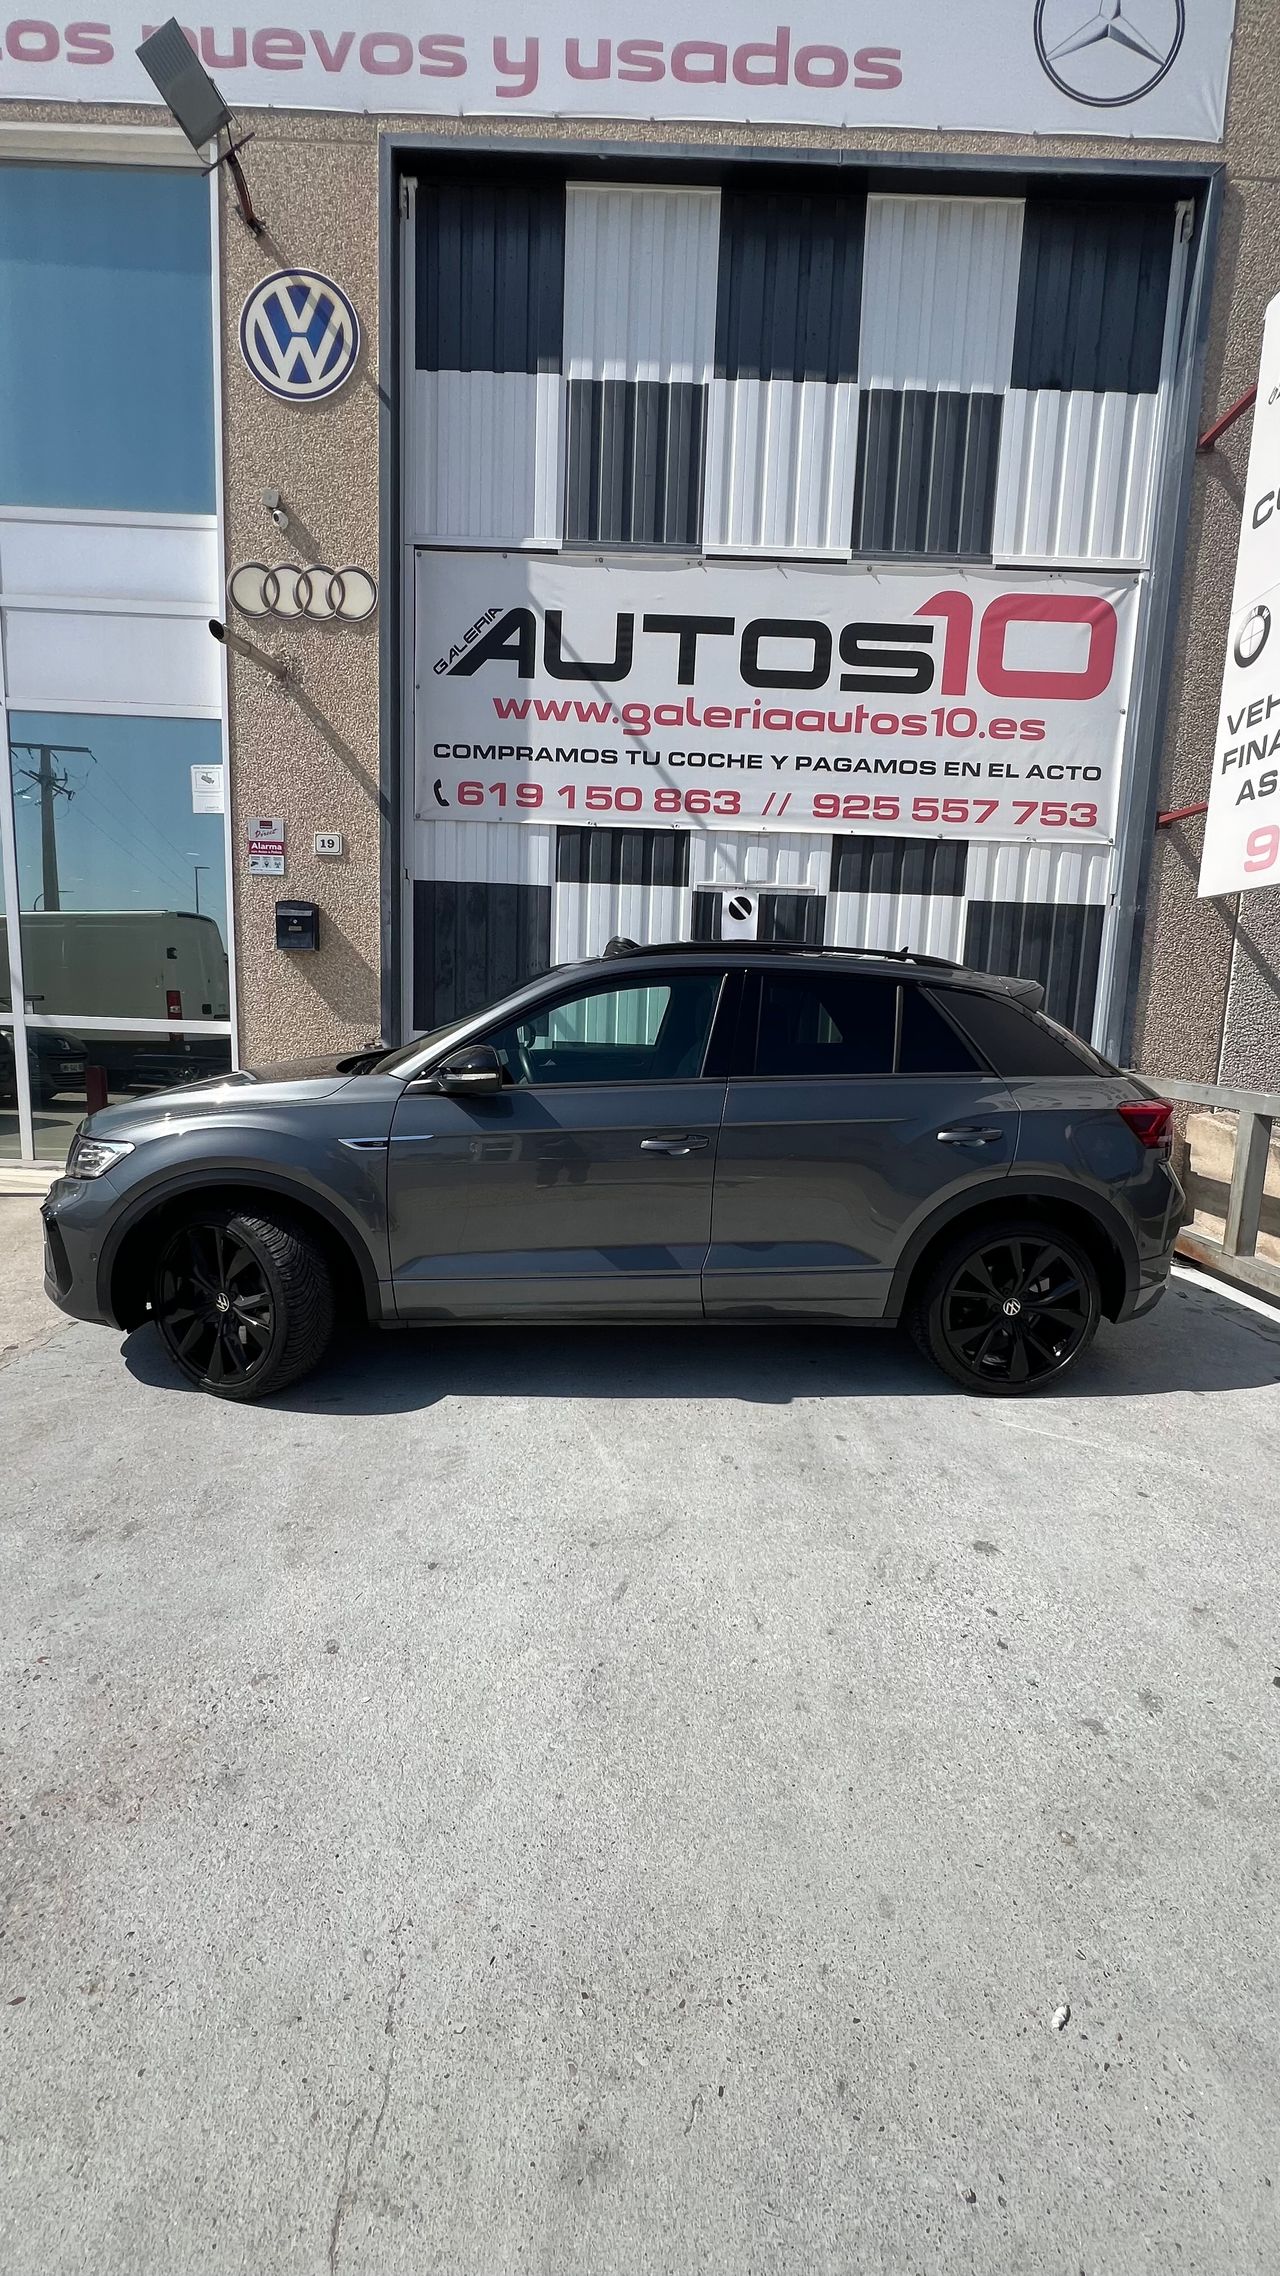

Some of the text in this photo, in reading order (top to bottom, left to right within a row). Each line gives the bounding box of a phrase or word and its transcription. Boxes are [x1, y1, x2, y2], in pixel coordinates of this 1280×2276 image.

[0, 18, 114, 65] os
[493, 36, 539, 98] y
[565, 26, 903, 90] usados
[433, 608, 504, 675] GALERIA
[446, 591, 1117, 701] AUTOS10
[493, 697, 1045, 741] www.galeriaautos10.es
[434, 743, 1102, 781] COMPRAMOS TU COCHE Y PAGAMOS EN EL ACTO
[458, 781, 544, 809] 619
[559, 785, 643, 812] 150
[653, 788, 740, 815] 863
[812, 793, 900, 821] 925
[911, 797, 999, 824] 557
[1012, 800, 1098, 828] 753
[251, 842, 282, 851] Alarma
[320, 839, 335, 849] 19
[1244, 824, 1280, 873] 9
